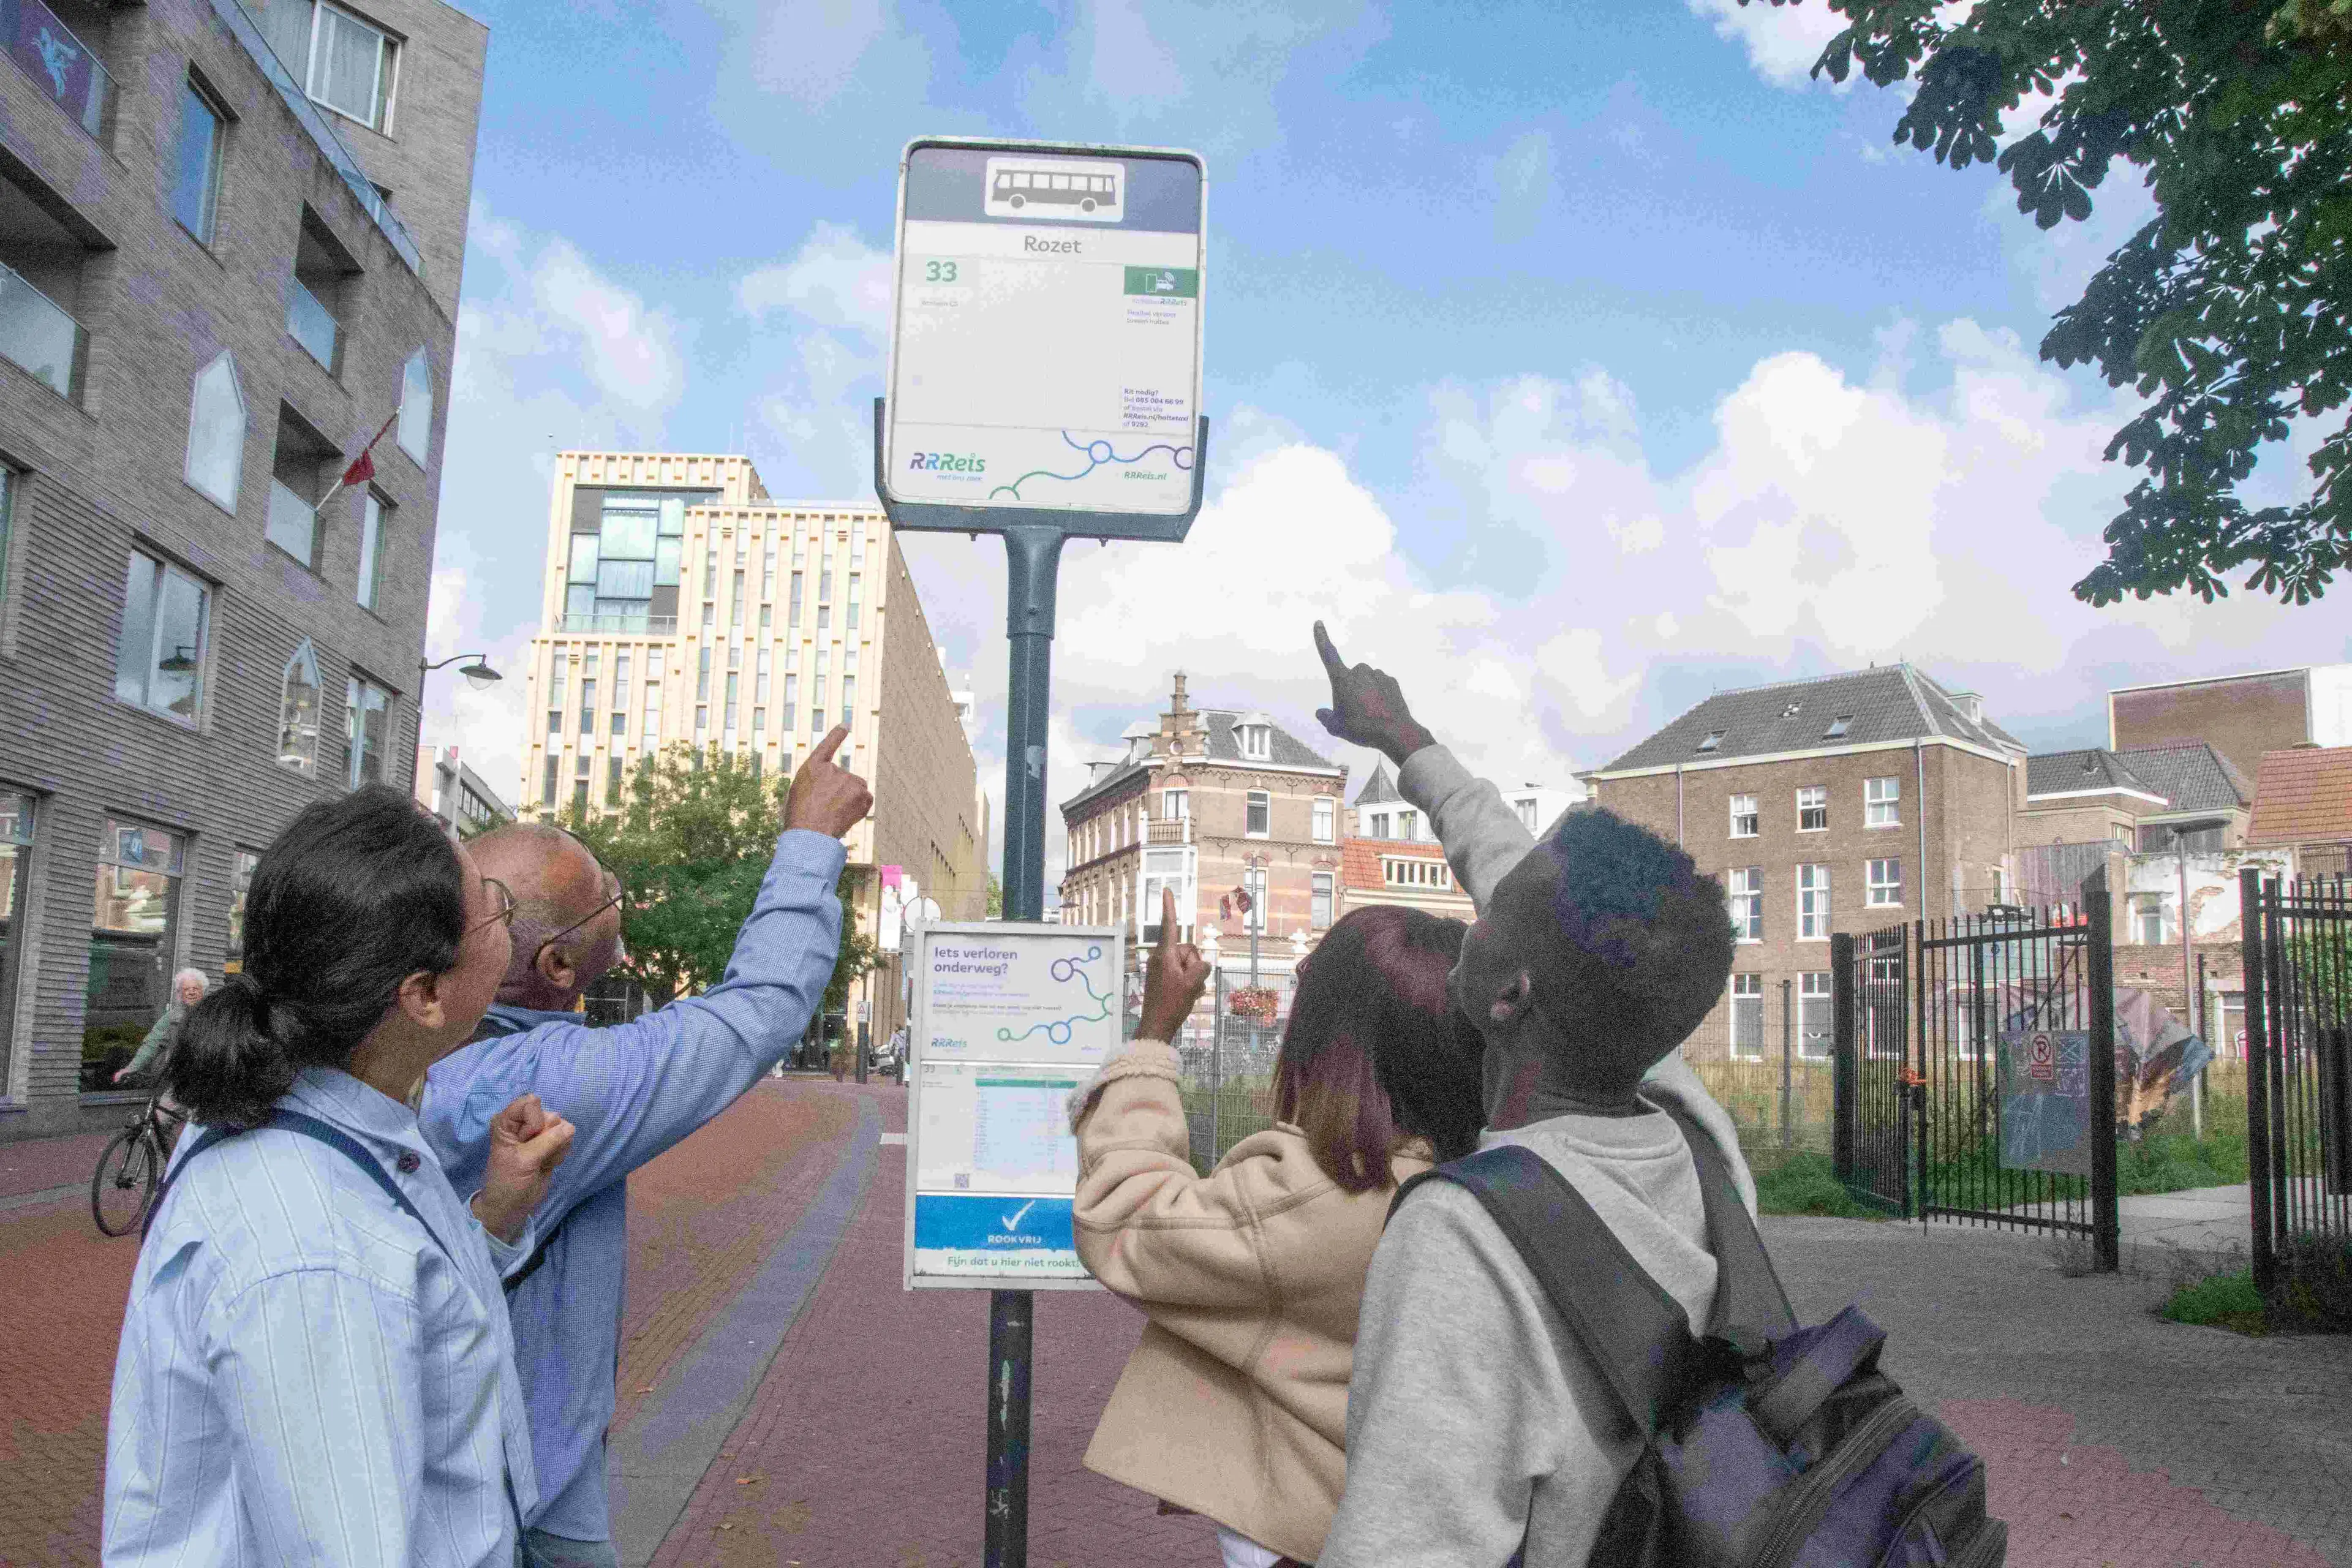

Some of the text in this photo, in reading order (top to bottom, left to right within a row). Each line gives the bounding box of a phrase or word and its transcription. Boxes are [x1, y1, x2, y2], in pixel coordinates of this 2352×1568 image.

[1024, 235, 1082, 254] Rozet
[926, 260, 957, 282] 33
[1136, 388, 1159, 397] nodig?
[910, 452, 986, 472] RRReis
[1125, 471, 1167, 481] RRReis.nl
[935, 947, 1018, 960] Iets verloren
[934, 962, 1009, 976] onderweg?
[948, 1256, 968, 1267] Fijn
[970, 1256, 989, 1266] dat
[1001, 1256, 1022, 1267] hier
[1024, 1257, 1045, 1267] niet
